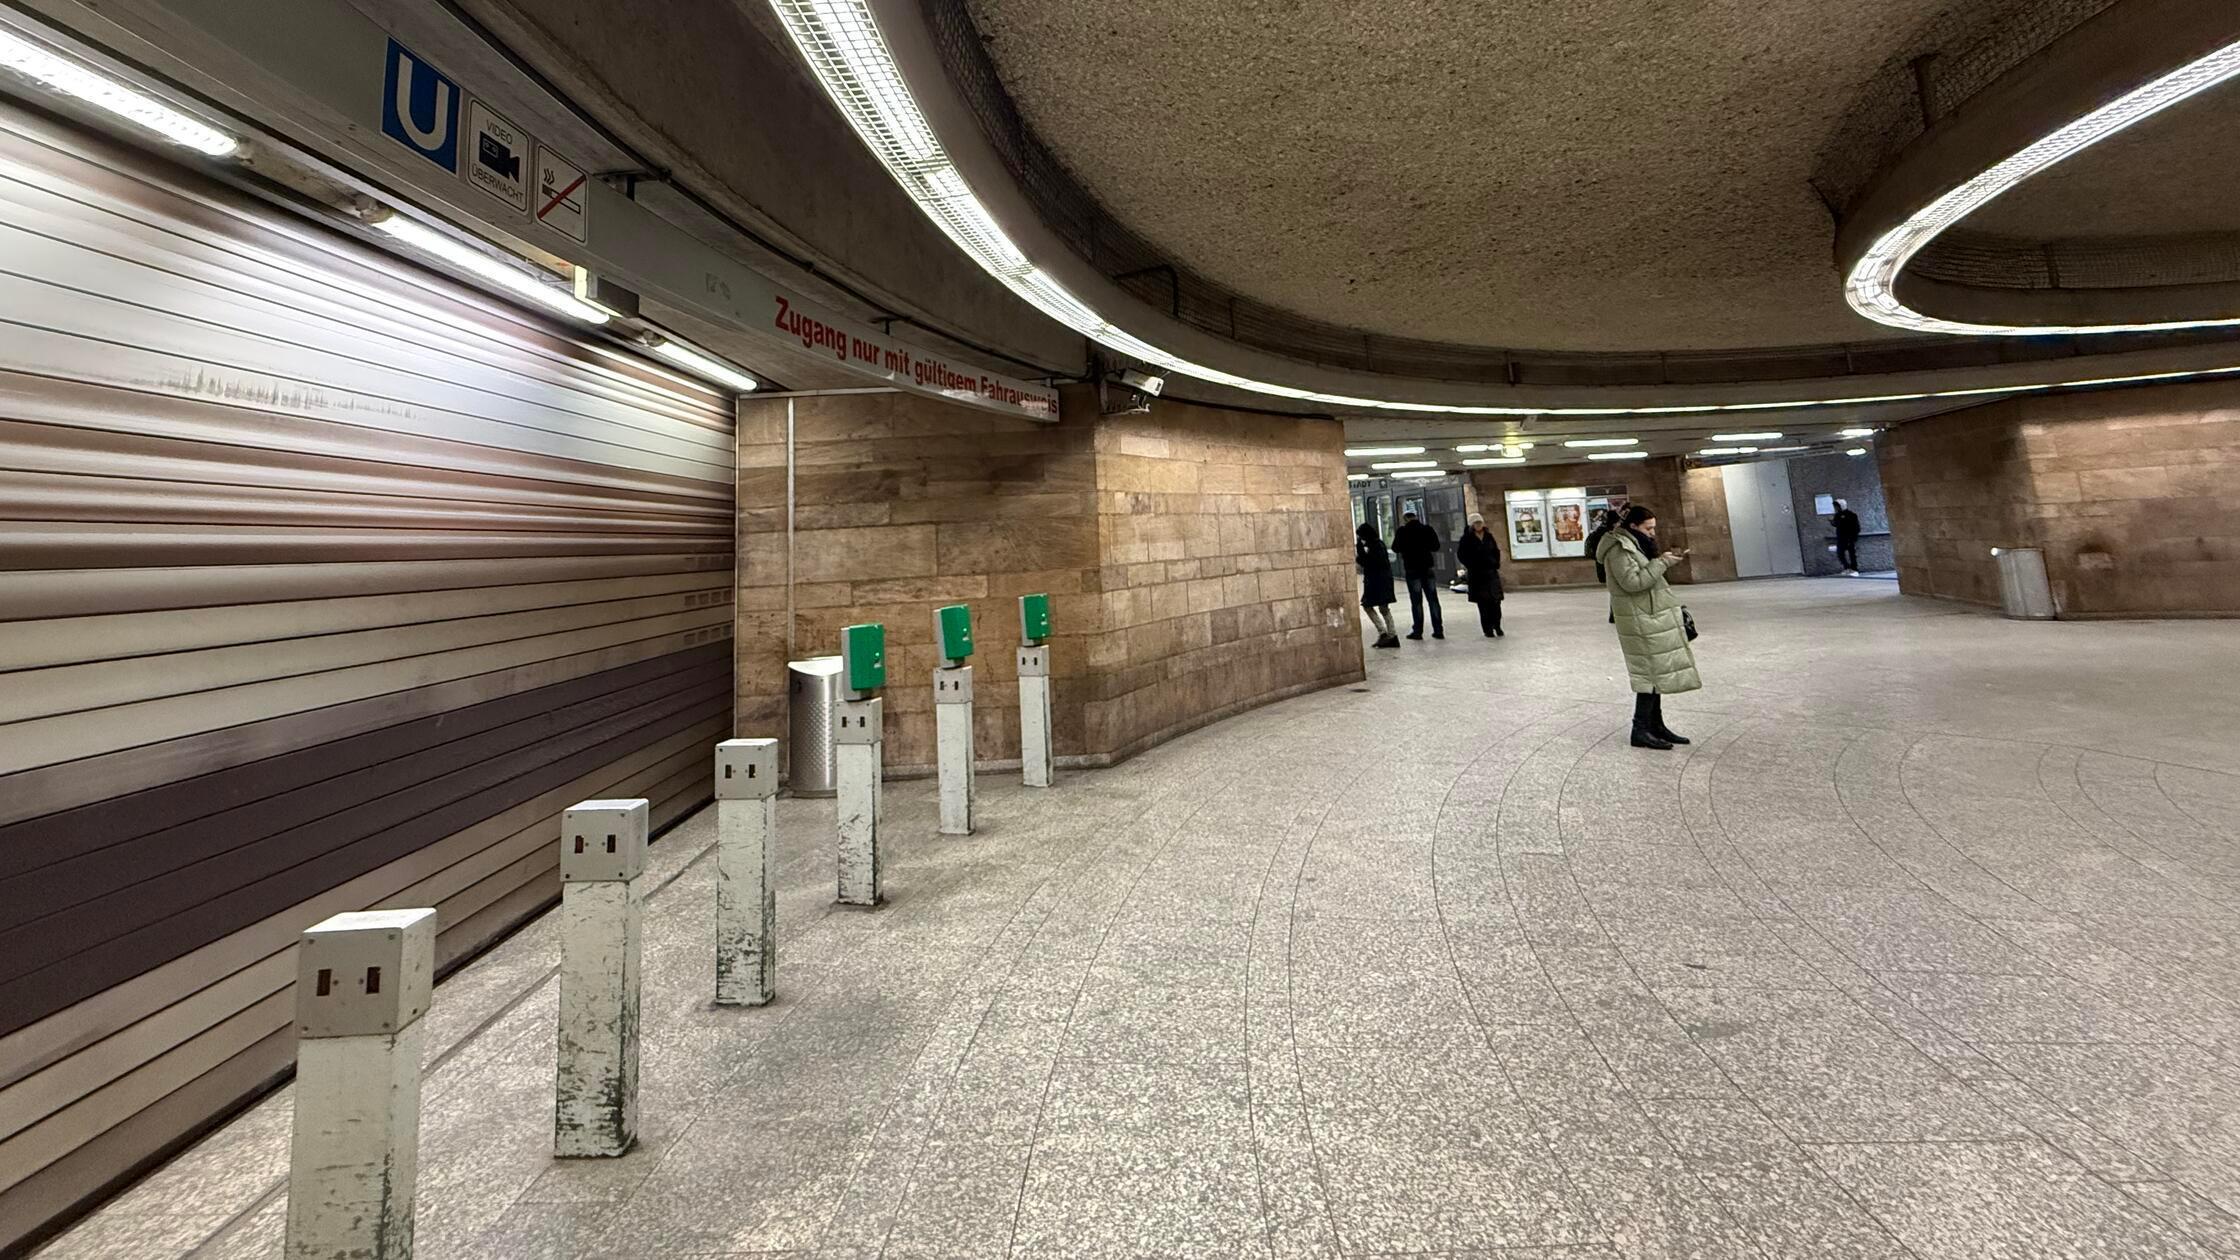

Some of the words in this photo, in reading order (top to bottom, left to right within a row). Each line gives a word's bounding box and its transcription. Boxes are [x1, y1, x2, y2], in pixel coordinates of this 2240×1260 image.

[396, 52, 450, 151] U
[486, 119, 513, 145] VIDEO
[471, 163, 524, 203] ÜBERWACHT
[775, 295, 847, 361] Zugang
[852, 337, 880, 365] nur
[884, 348, 910, 376] mit
[914, 358, 977, 393] gültigem
